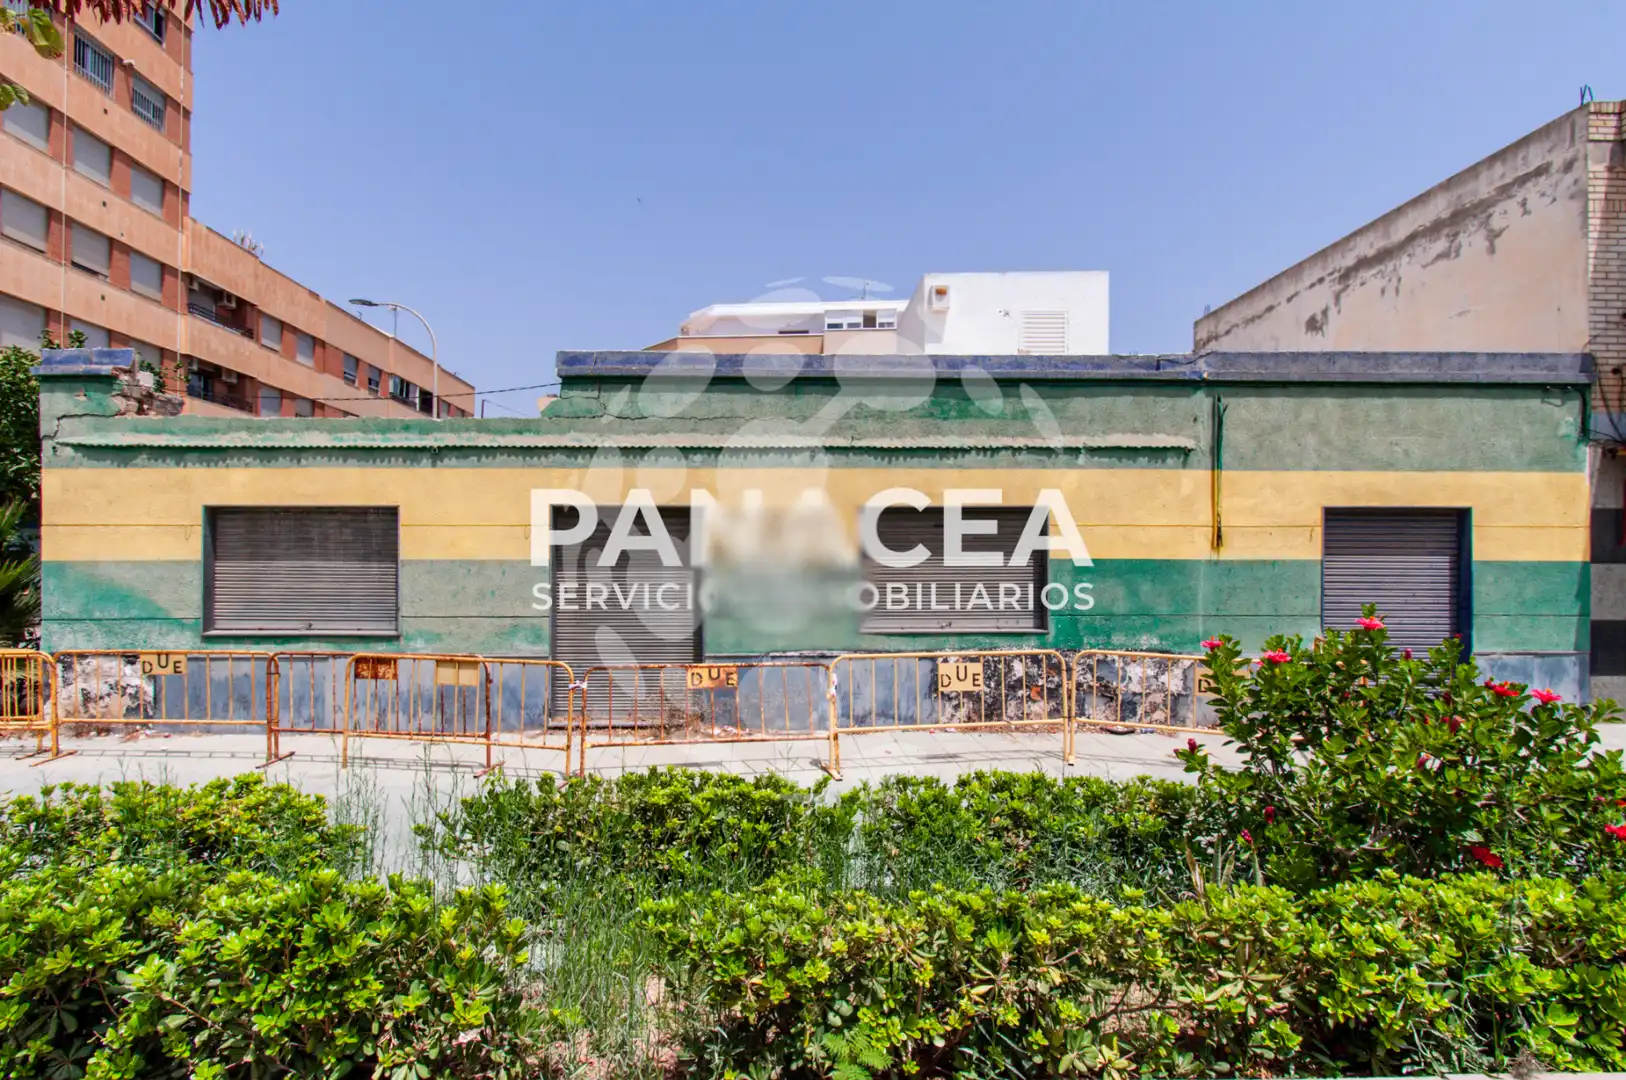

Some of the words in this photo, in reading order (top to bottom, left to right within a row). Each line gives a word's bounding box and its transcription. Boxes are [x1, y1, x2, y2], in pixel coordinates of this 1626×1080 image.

[142, 653, 182, 674] DUE
[691, 667, 735, 686] DUE
[940, 665, 981, 687] DUE
